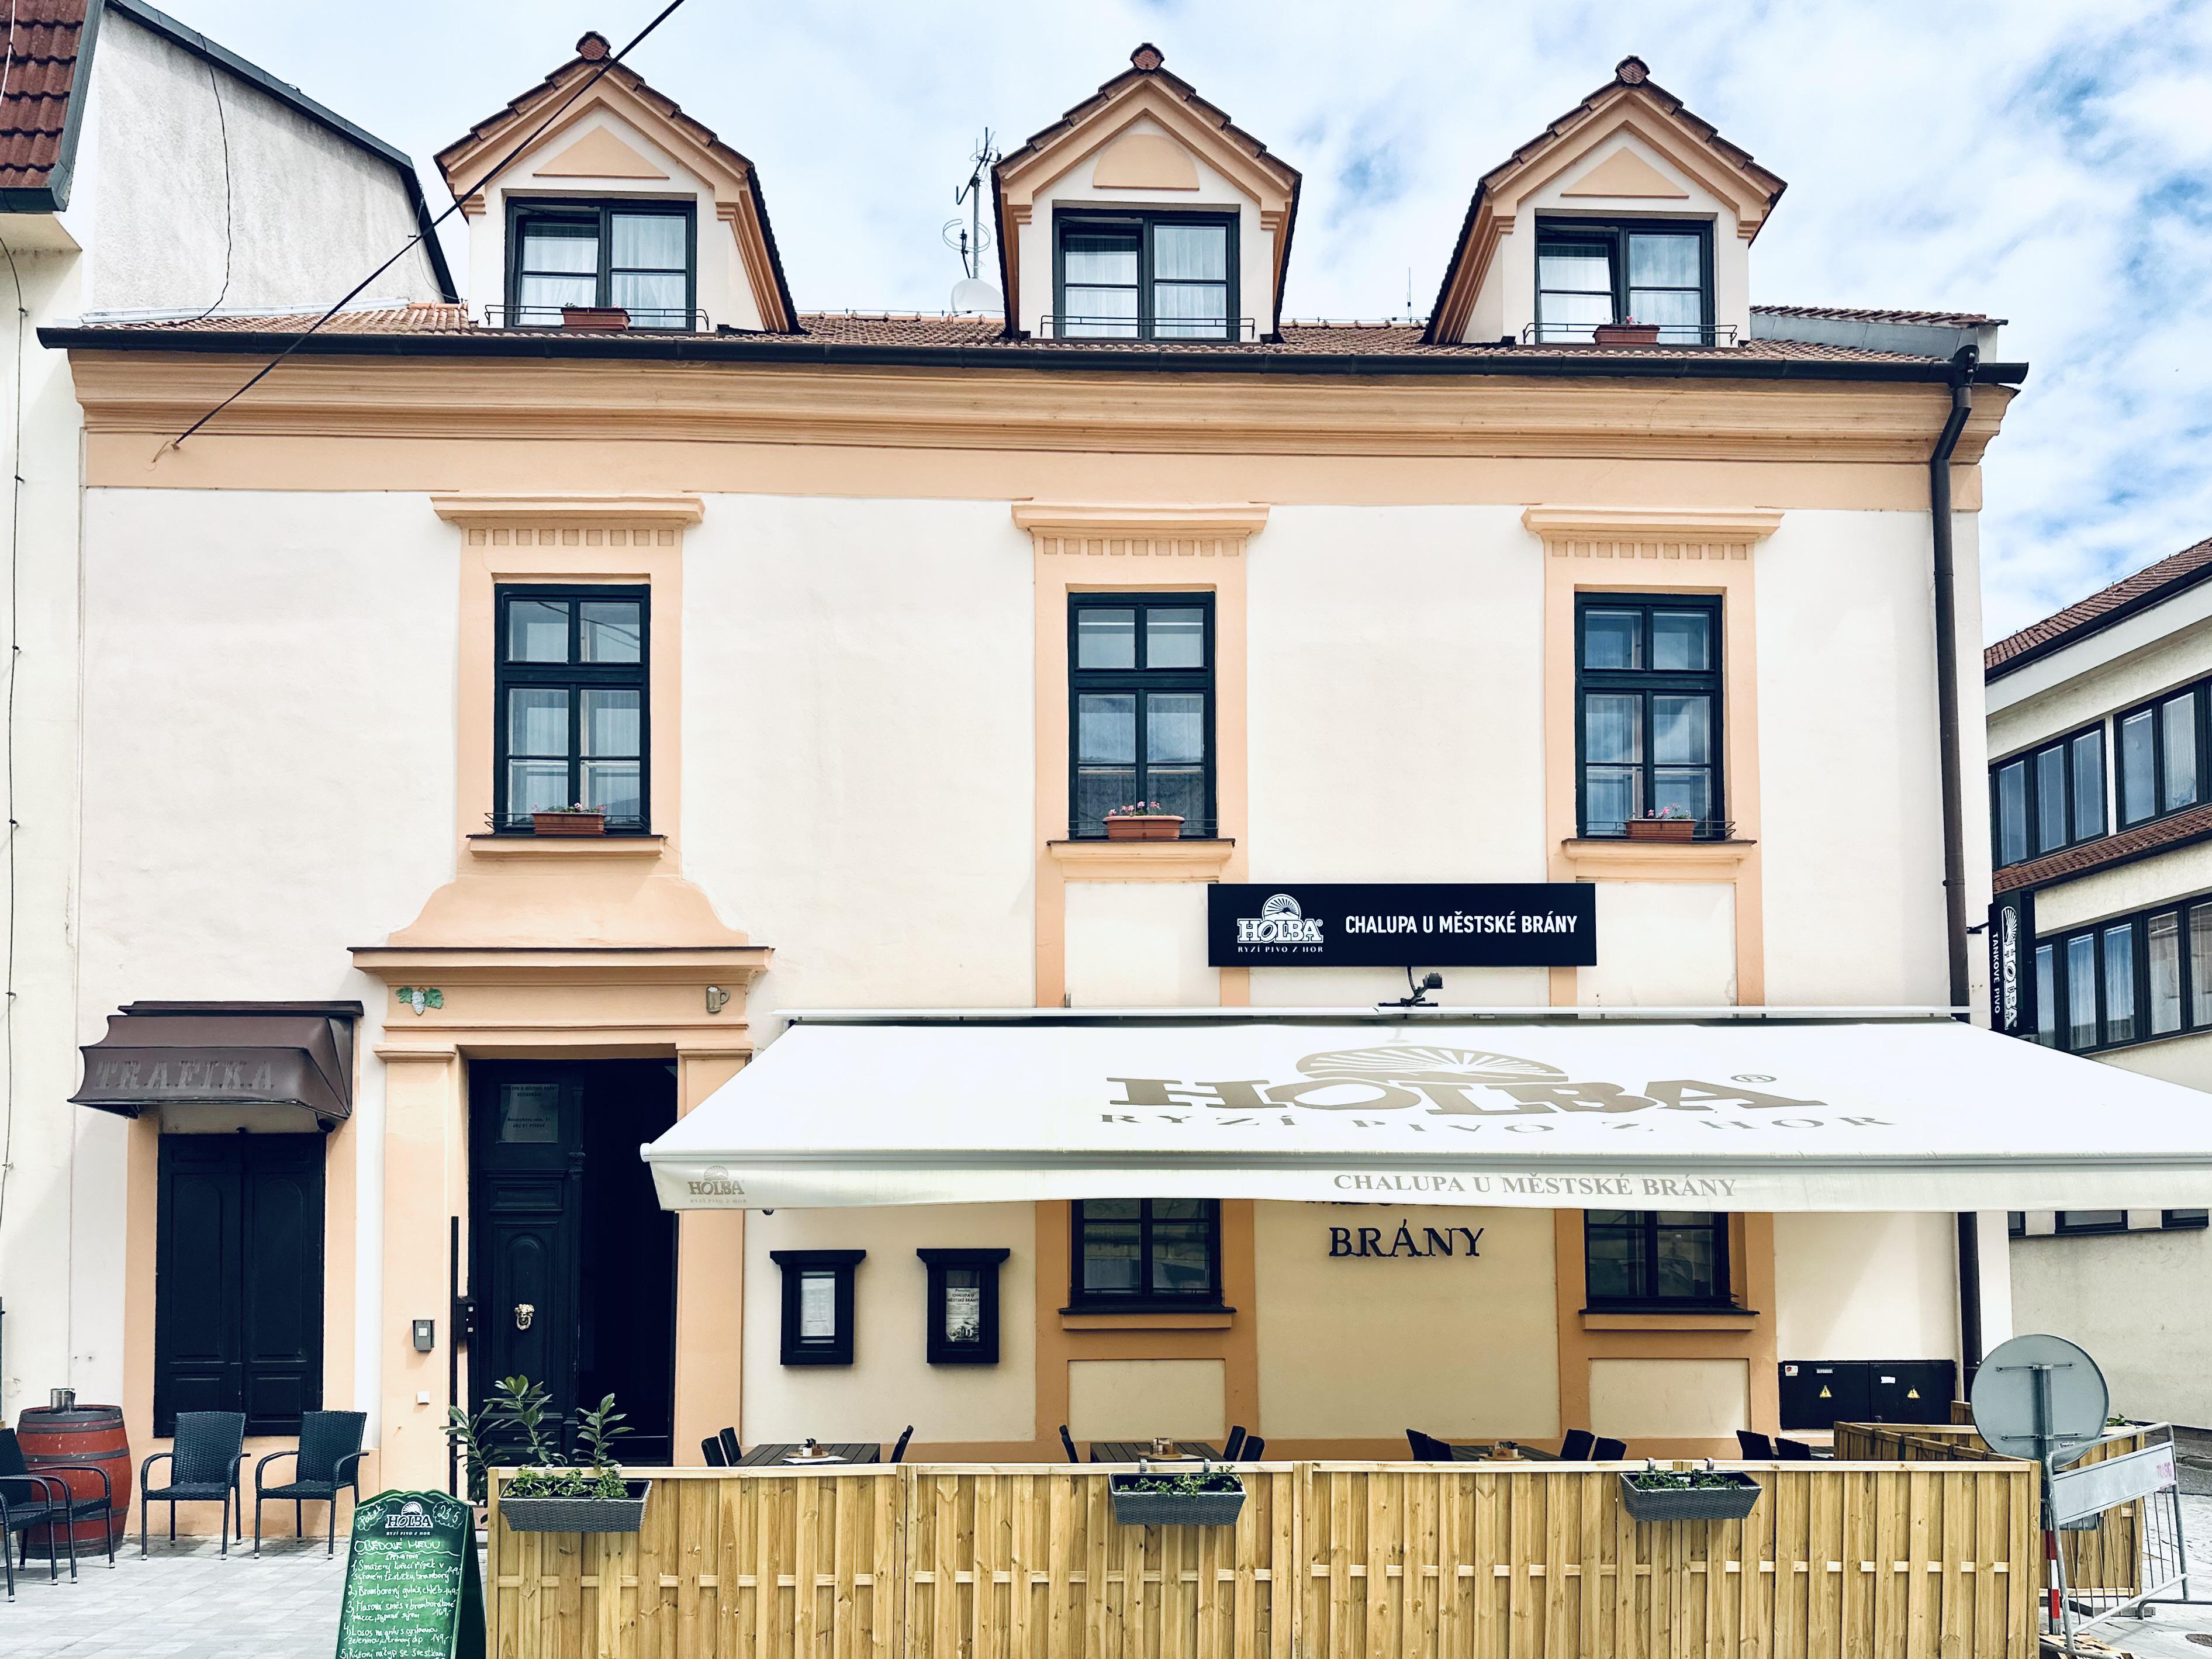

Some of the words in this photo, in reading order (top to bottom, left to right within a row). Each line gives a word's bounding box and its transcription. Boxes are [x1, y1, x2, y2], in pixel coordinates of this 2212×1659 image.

[1237, 918, 1323, 943] HOLBA
[1345, 915, 1418, 934] CHALUPA
[1422, 915, 1434, 934] U
[1439, 910, 1516, 934] MĚSTSKÉ
[1521, 910, 1578, 934] BRÁNY
[1238, 945, 1260, 953] RYZÍ
[2003, 942, 2017, 1031] HOLBA
[94, 1060, 275, 1091] TRAFIKA
[1106, 1077, 1829, 1115] HOLBA
[1100, 1114, 1298, 1126] RYZÍ
[1352, 1119, 1555, 1133] PIVO
[1601, 1121, 1655, 1132] Z
[1698, 1117, 1896, 1130] HOR
[687, 1180, 745, 1195] HOLBA
[1333, 1174, 1466, 1193] CHALUPA
[1473, 1177, 1491, 1194] U
[1502, 1172, 1633, 1196] MĚSTSKÉ
[1643, 1173, 1737, 1197] BRÁNY
[1329, 1218, 1485, 1257] BRÁNY
[385, 1515, 434, 1528] HOLBA
[412, 1636, 423, 1645] dip
